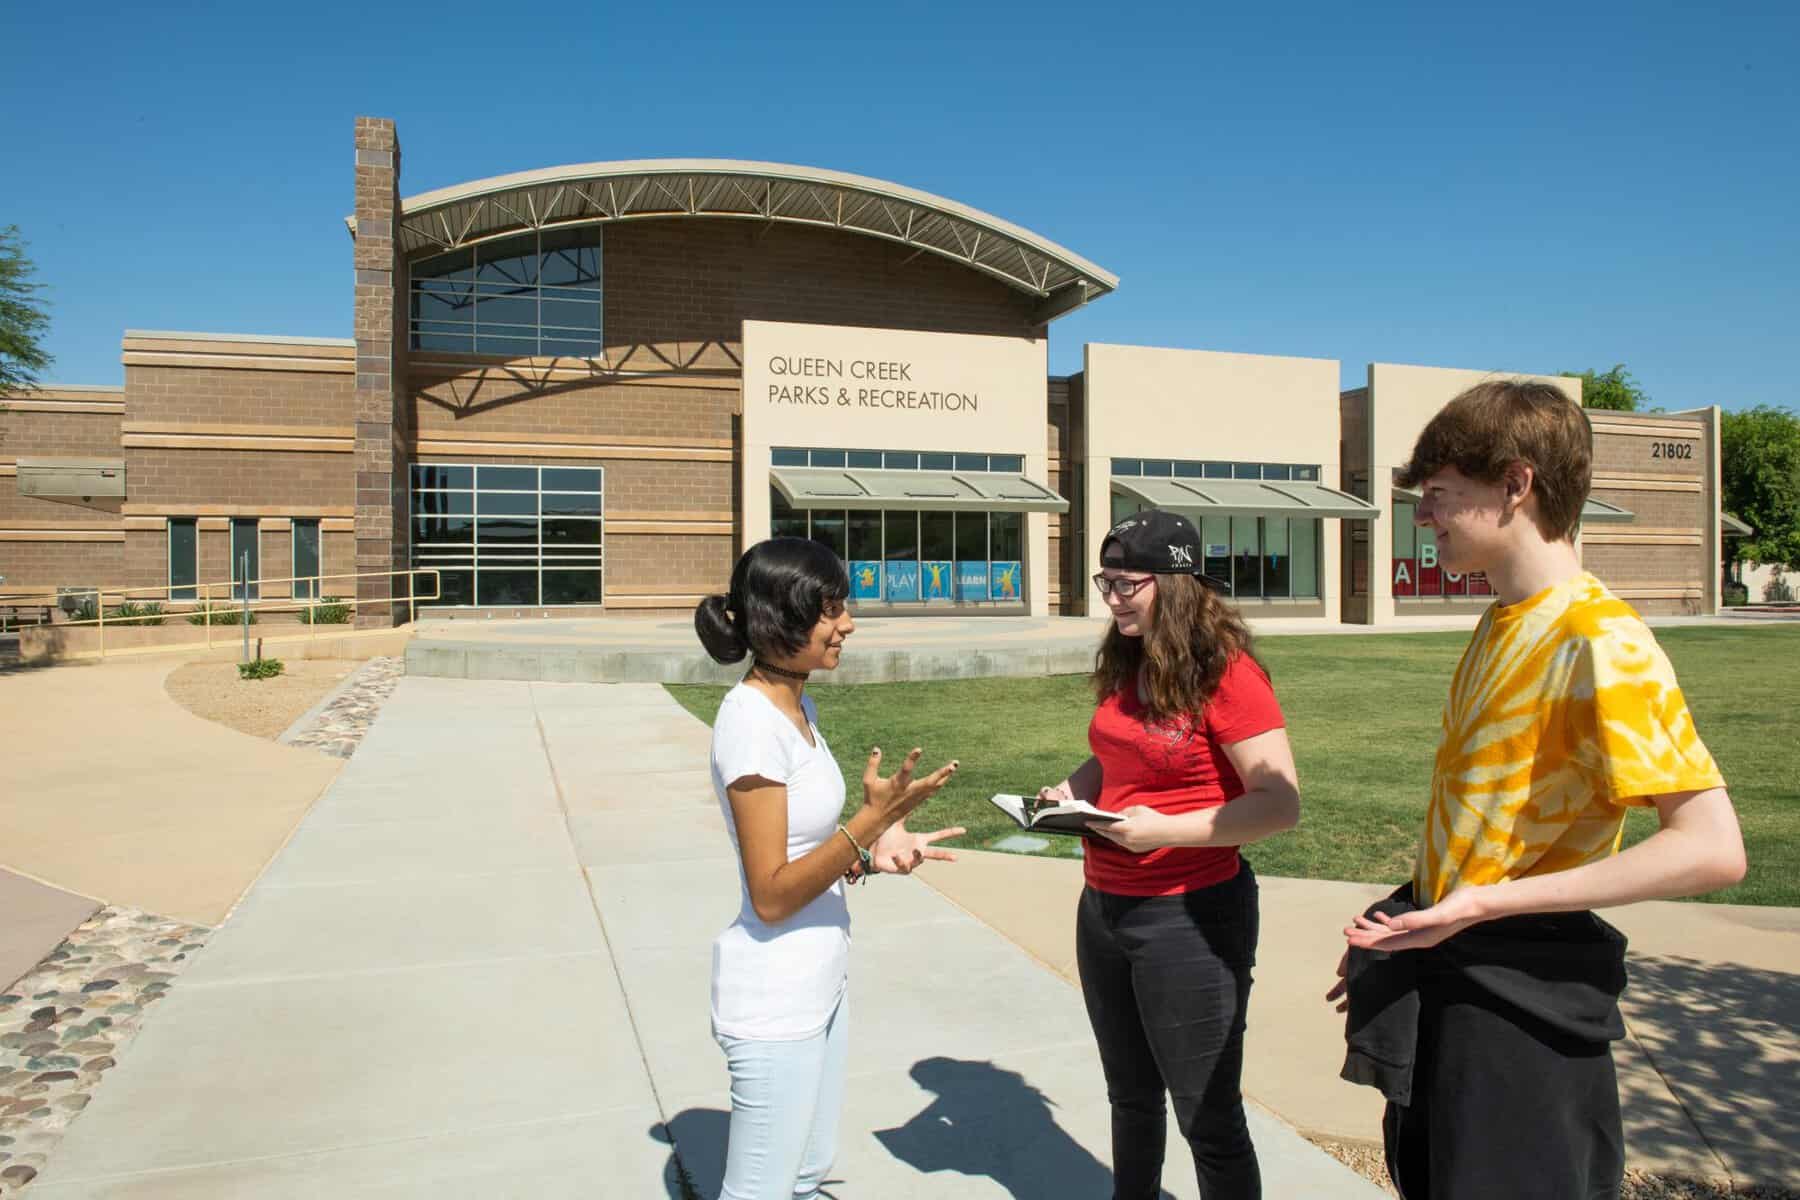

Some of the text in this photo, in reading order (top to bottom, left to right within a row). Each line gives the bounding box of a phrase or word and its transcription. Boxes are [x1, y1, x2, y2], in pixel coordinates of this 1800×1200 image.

[768, 356, 912, 381] QUEEN CREEK
[768, 385, 978, 411] PARKS & RECREATION
[1651, 442, 1692, 459] 21802
